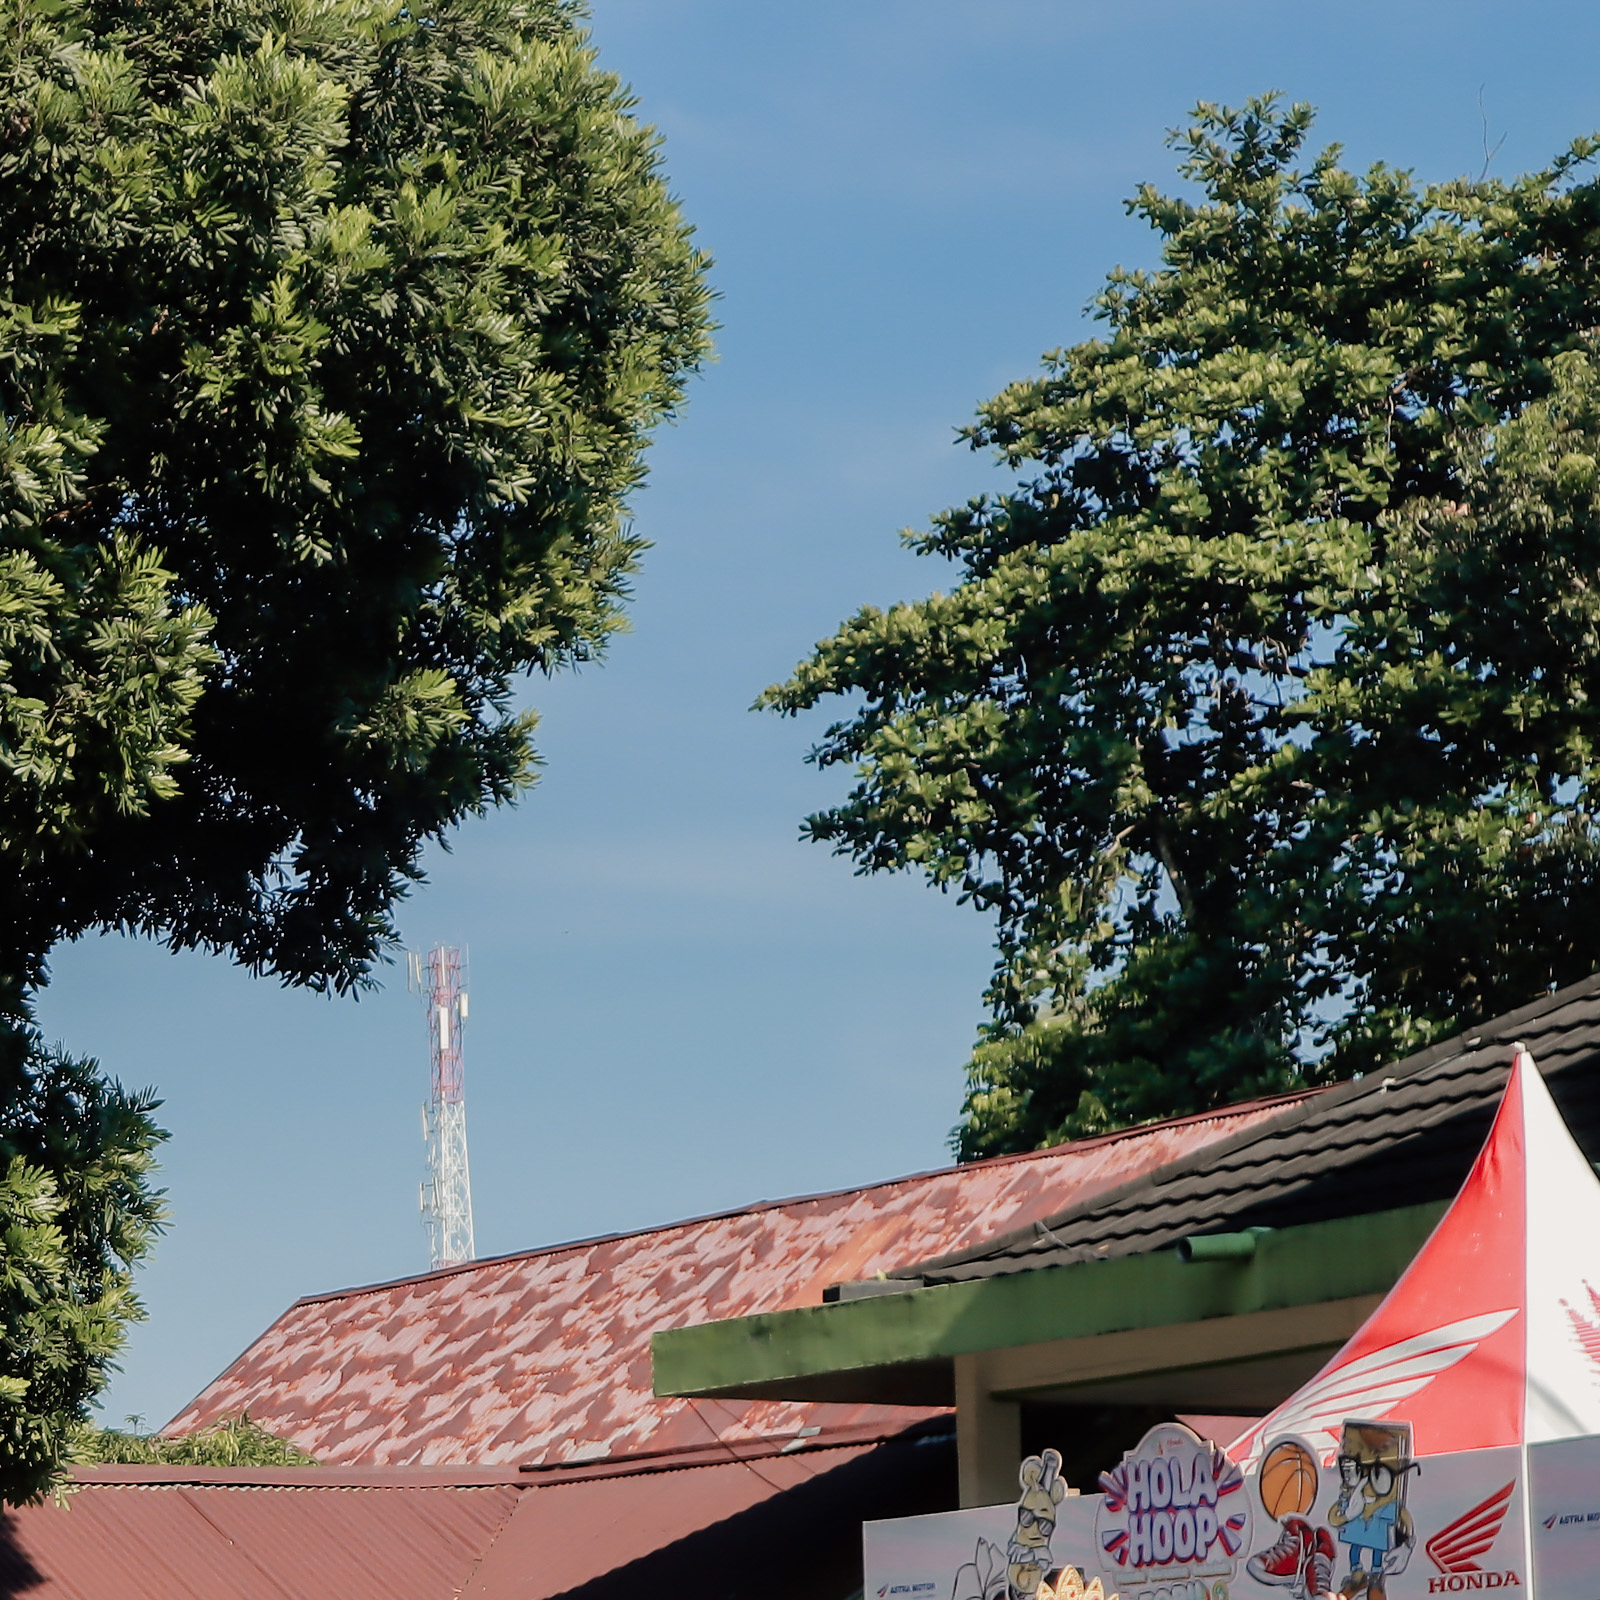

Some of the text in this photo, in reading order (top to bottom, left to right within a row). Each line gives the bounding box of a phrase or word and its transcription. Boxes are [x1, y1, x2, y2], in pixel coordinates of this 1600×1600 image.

[1127, 1453, 1218, 1513] HOLA
[1129, 1506, 1219, 1566] HOOP
[1428, 1570, 1521, 1594] HONDA
